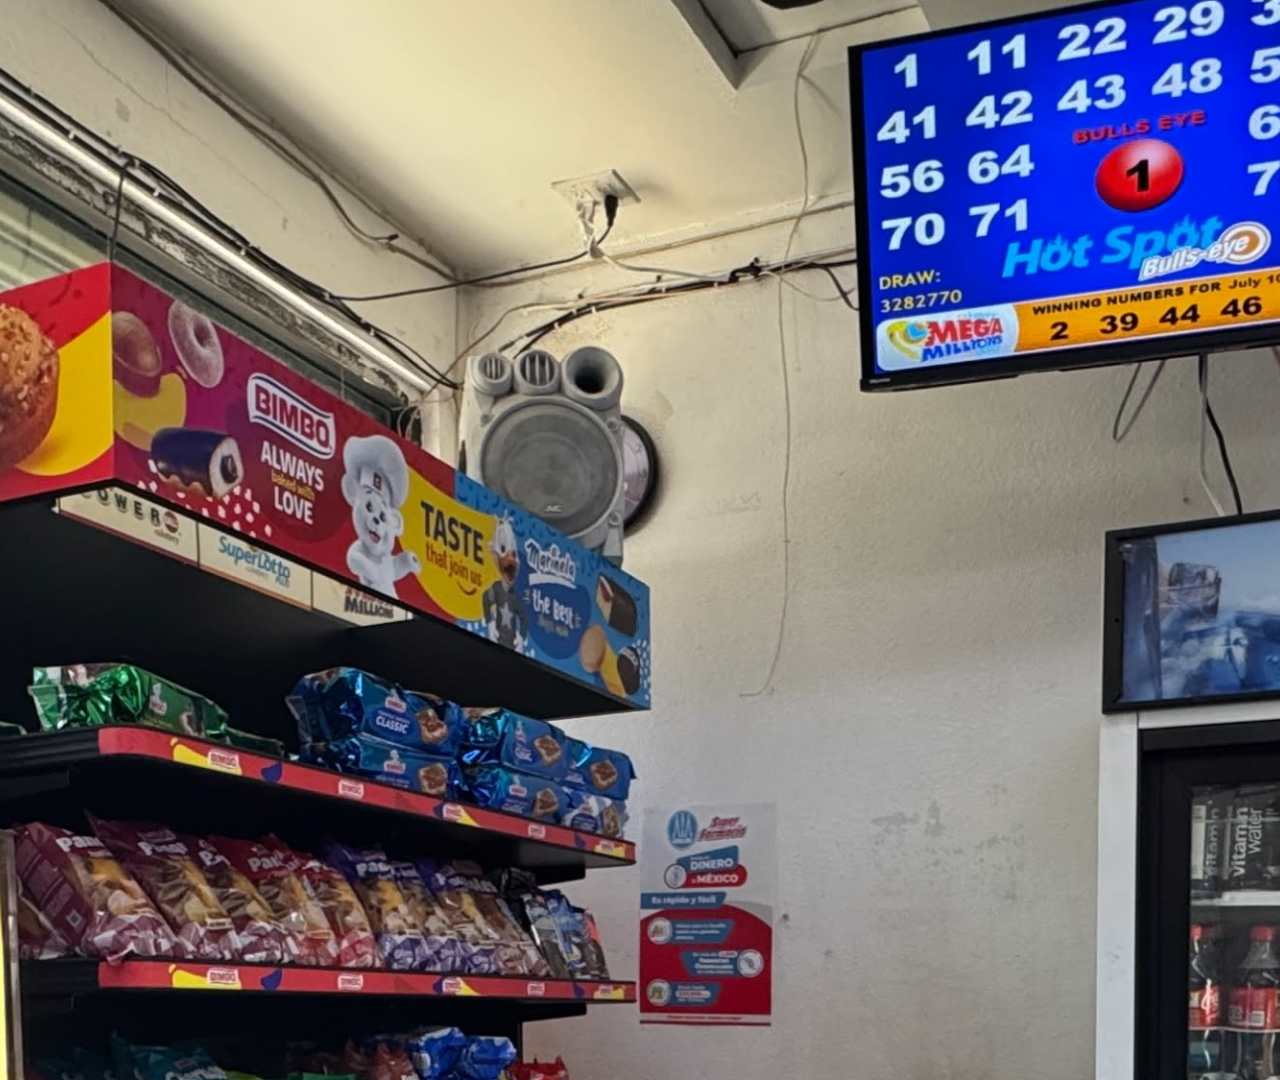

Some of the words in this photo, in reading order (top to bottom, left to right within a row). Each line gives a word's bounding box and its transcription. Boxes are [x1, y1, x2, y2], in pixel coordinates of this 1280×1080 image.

[1152, 0, 1225, 44] 29
[894, 54, 918, 88] 1
[968, 34, 1026, 75] 11
[1057, 17, 1127, 61] 22
[877, 105, 936, 144] 41
[966, 90, 1033, 129] 42
[1057, 75, 1127, 113] 43
[1152, 58, 1223, 98] 48
[1073, 121, 1151, 145] BULLS
[1158, 109, 1207, 131] EYE
[881, 160, 945, 198] 56
[968, 144, 1034, 184] 64
[1127, 159, 1150, 192] 1
[882, 213, 945, 250] 70
[969, 199, 1028, 237] 71
[1002, 233, 1094, 278] Hot
[1101, 213, 1224, 270] Spot
[879, 270, 942, 290] DRAW:
[1138, 234, 1250, 282] Bulls-eye
[880, 289, 962, 313] 3282770
[1032, 298, 1102, 316] WINNING
[1107, 286, 1184, 306] NUMBERS
[1190, 282, 1221, 300] FOR
[1229, 276, 1261, 290] July
[927, 317, 1003, 346] MEGA
[1051, 321, 1069, 341] 2
[1100, 312, 1139, 335] 39
[1159, 304, 1200, 326] 44
[1221, 296, 1262, 318] 46
[922, 335, 1003, 362] MILLIONS
[255, 382, 331, 450] BIMBO
[261, 440, 325, 492] ALWAYS
[274, 486, 314, 526] LOVE
[421, 500, 485, 565] TASTE
[425, 543, 448, 570] that
[525, 539, 577, 584] Marinela
[532, 588, 550, 615] the
[375, 715, 409, 733] CLASSIC
